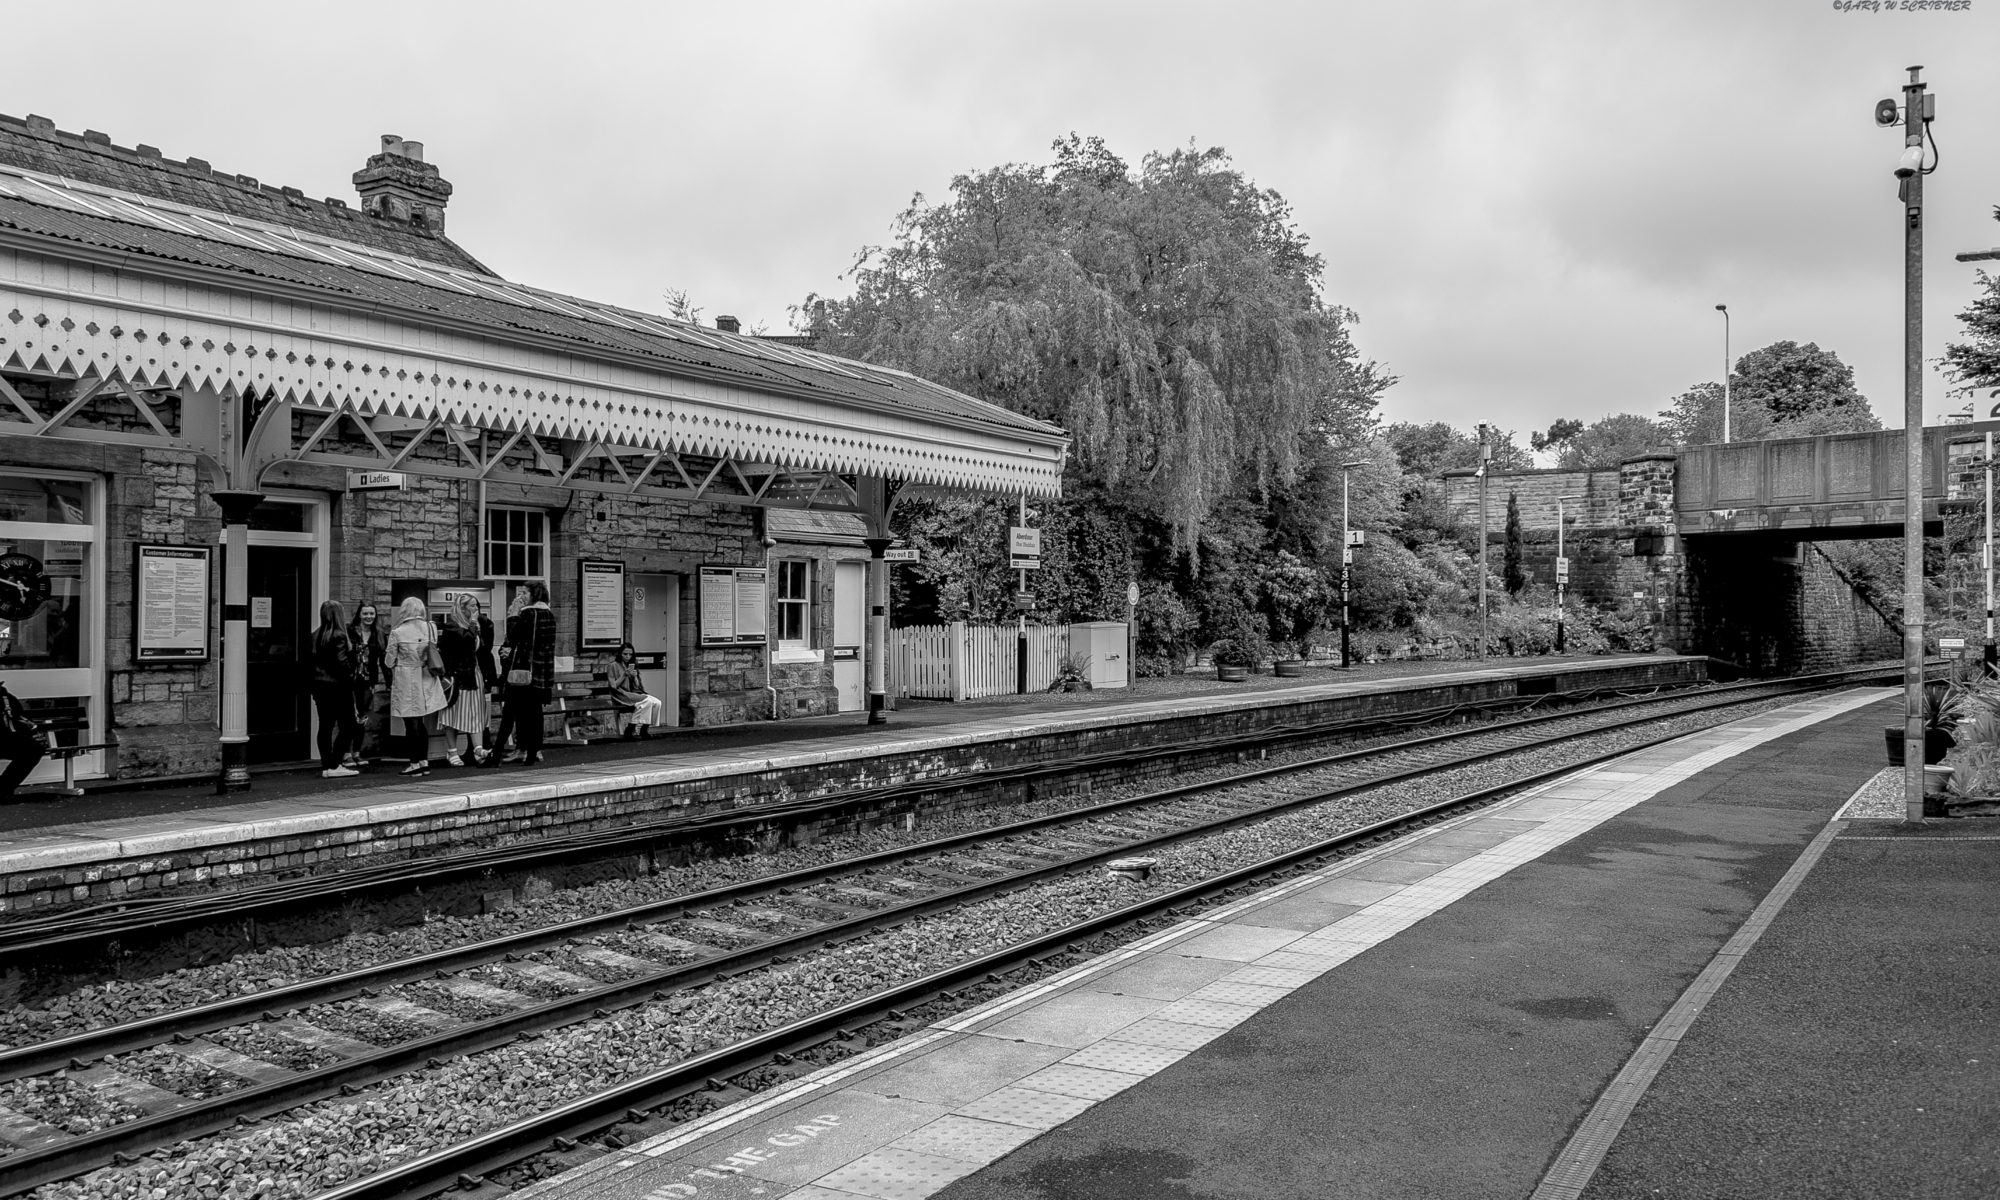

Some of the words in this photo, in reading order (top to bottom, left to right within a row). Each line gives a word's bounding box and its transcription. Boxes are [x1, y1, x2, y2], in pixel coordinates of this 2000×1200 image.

[369, 473, 390, 484] Ladies
[1352, 531, 1359, 543] 1
[145, 549, 167, 557] Customer
[167, 550, 194, 558] Information
[885, 551, 896, 559] Way
[1341, 570, 1349, 579] 3
[1341, 580, 1349, 589] 4
[687, 1146, 780, 1179] THE
[767, 1114, 843, 1147] GAP
